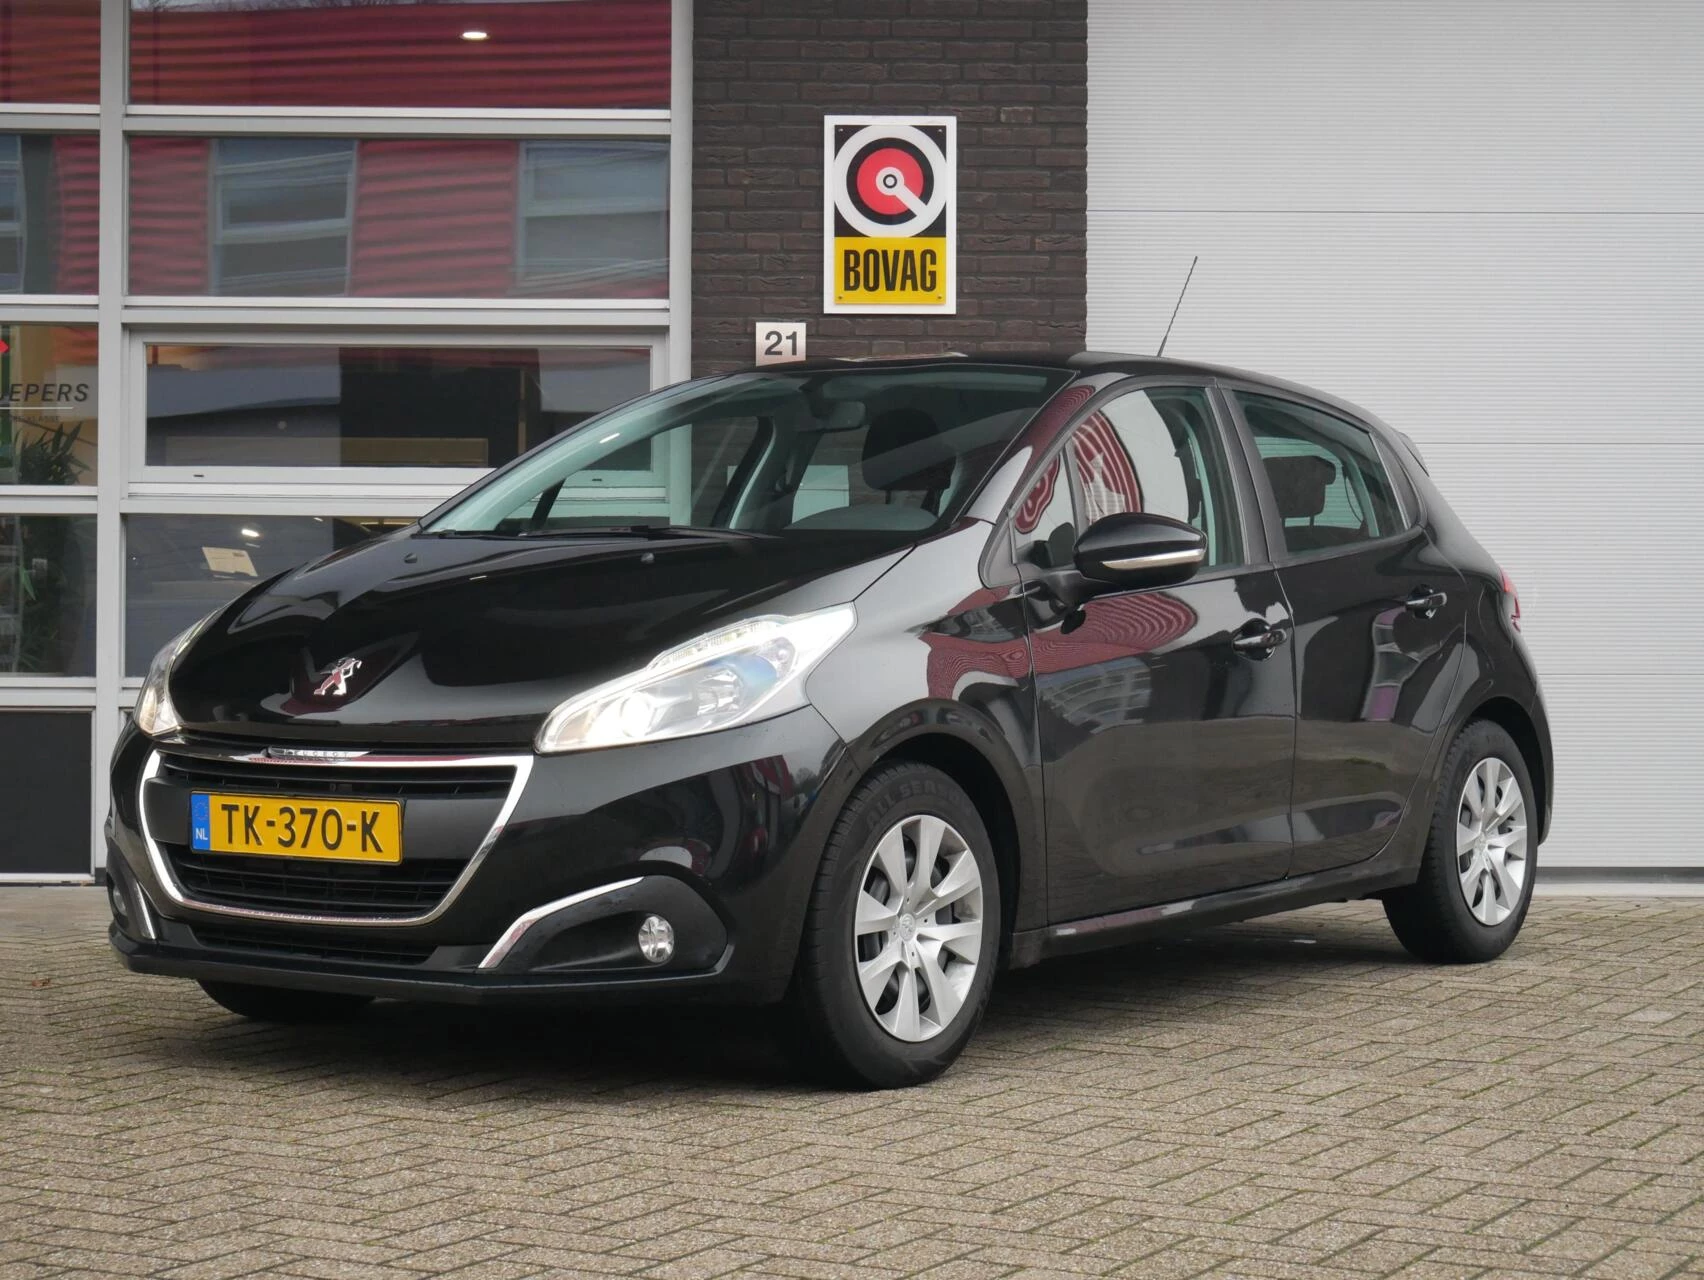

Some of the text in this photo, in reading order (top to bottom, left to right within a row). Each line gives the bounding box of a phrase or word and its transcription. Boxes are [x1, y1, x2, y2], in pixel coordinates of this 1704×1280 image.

[844, 249, 937, 292] BOVAG
[765, 331, 798, 356] 21
[195, 828, 209, 841] NL
[221, 804, 384, 853] TK-370-K
